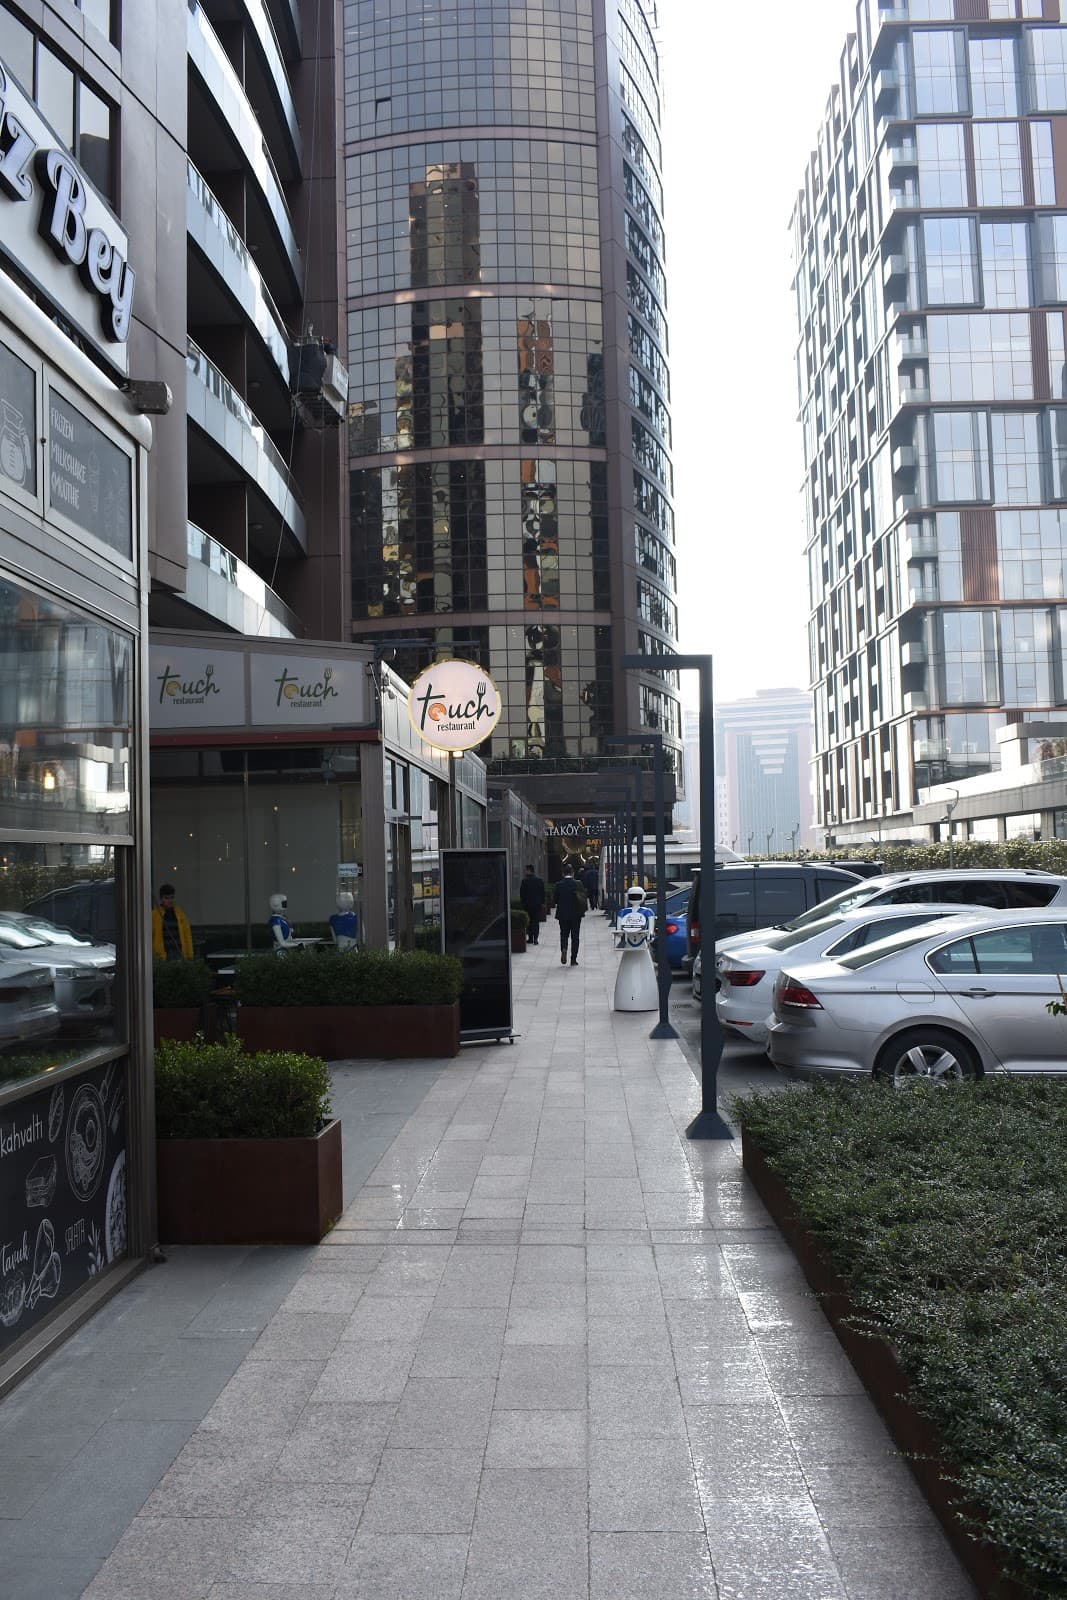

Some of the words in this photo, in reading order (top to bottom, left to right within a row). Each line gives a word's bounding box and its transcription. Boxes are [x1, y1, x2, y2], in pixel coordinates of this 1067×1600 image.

[38, 148, 135, 343] Bey
[51, 407, 74, 442] FROZEN
[51, 439, 87, 484] MILKSHAKE
[173, 696, 205, 705] restaurant
[290, 699, 323, 708] restaurant
[416, 681, 495, 731] touch
[437, 720, 476, 732] restaurant
[0, 1230, 29, 1276] Tavuk
[65, 1217, 86, 1256] SALATA
